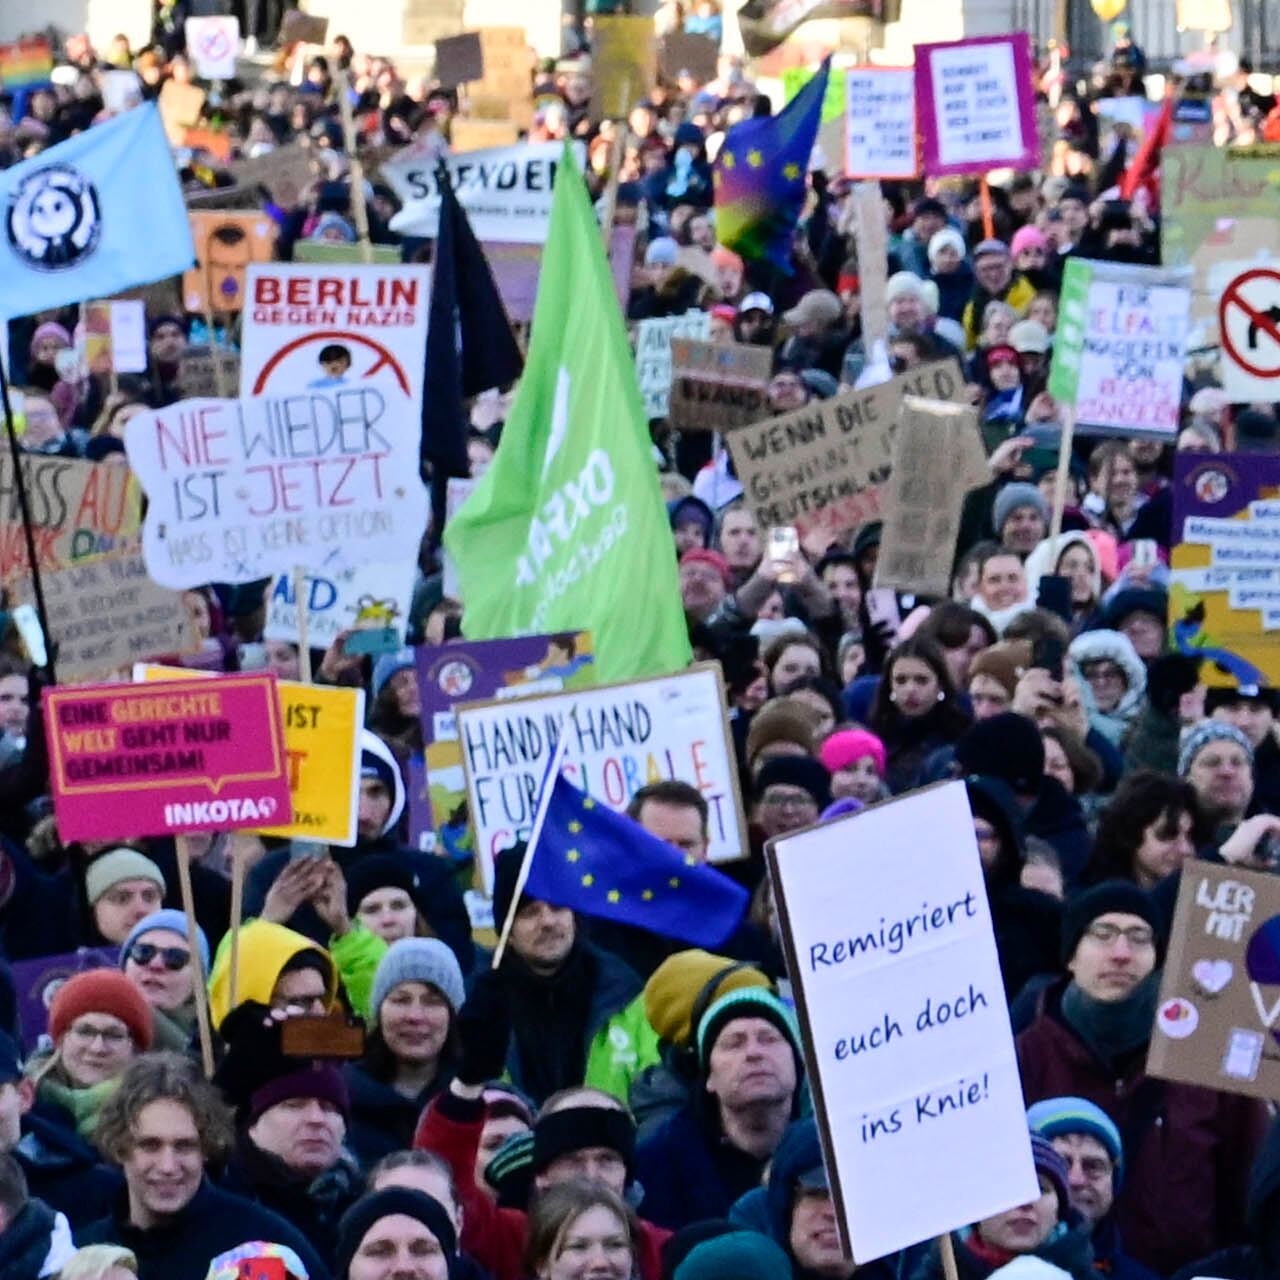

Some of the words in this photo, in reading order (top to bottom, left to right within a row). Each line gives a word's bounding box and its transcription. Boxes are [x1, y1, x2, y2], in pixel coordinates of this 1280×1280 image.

[255, 278, 419, 306] BERLIN
[253, 310, 337, 325] GEGEN
[347, 309, 417, 326] NAZIS
[155, 404, 230, 472] NIE
[236, 387, 393, 462] WIEDER
[742, 413, 826, 462] WENN
[838, 395, 882, 436] DIE
[172, 471, 227, 524] IST
[245, 452, 388, 518] JETZT
[756, 464, 893, 528] DEUTSCHLAN
[261, 520, 312, 551] KEINE
[60, 701, 110, 726] EINE
[111, 693, 222, 723] GERECHTE
[286, 704, 322, 729] IST
[65, 728, 118, 755] WELT
[122, 724, 180, 751] GEHT
[184, 721, 231, 747] NUR
[464, 714, 539, 773] HAND
[574, 699, 653, 750] HAND
[66, 750, 206, 783] GEMEINSAM!
[165, 798, 259, 827] INKOTA
[810, 890, 977, 972] Remigriert
[834, 1013, 902, 1061] euch
[915, 983, 989, 1032] doch
[859, 1108, 902, 1144] ins
[915, 1073, 990, 1126] Knie!
